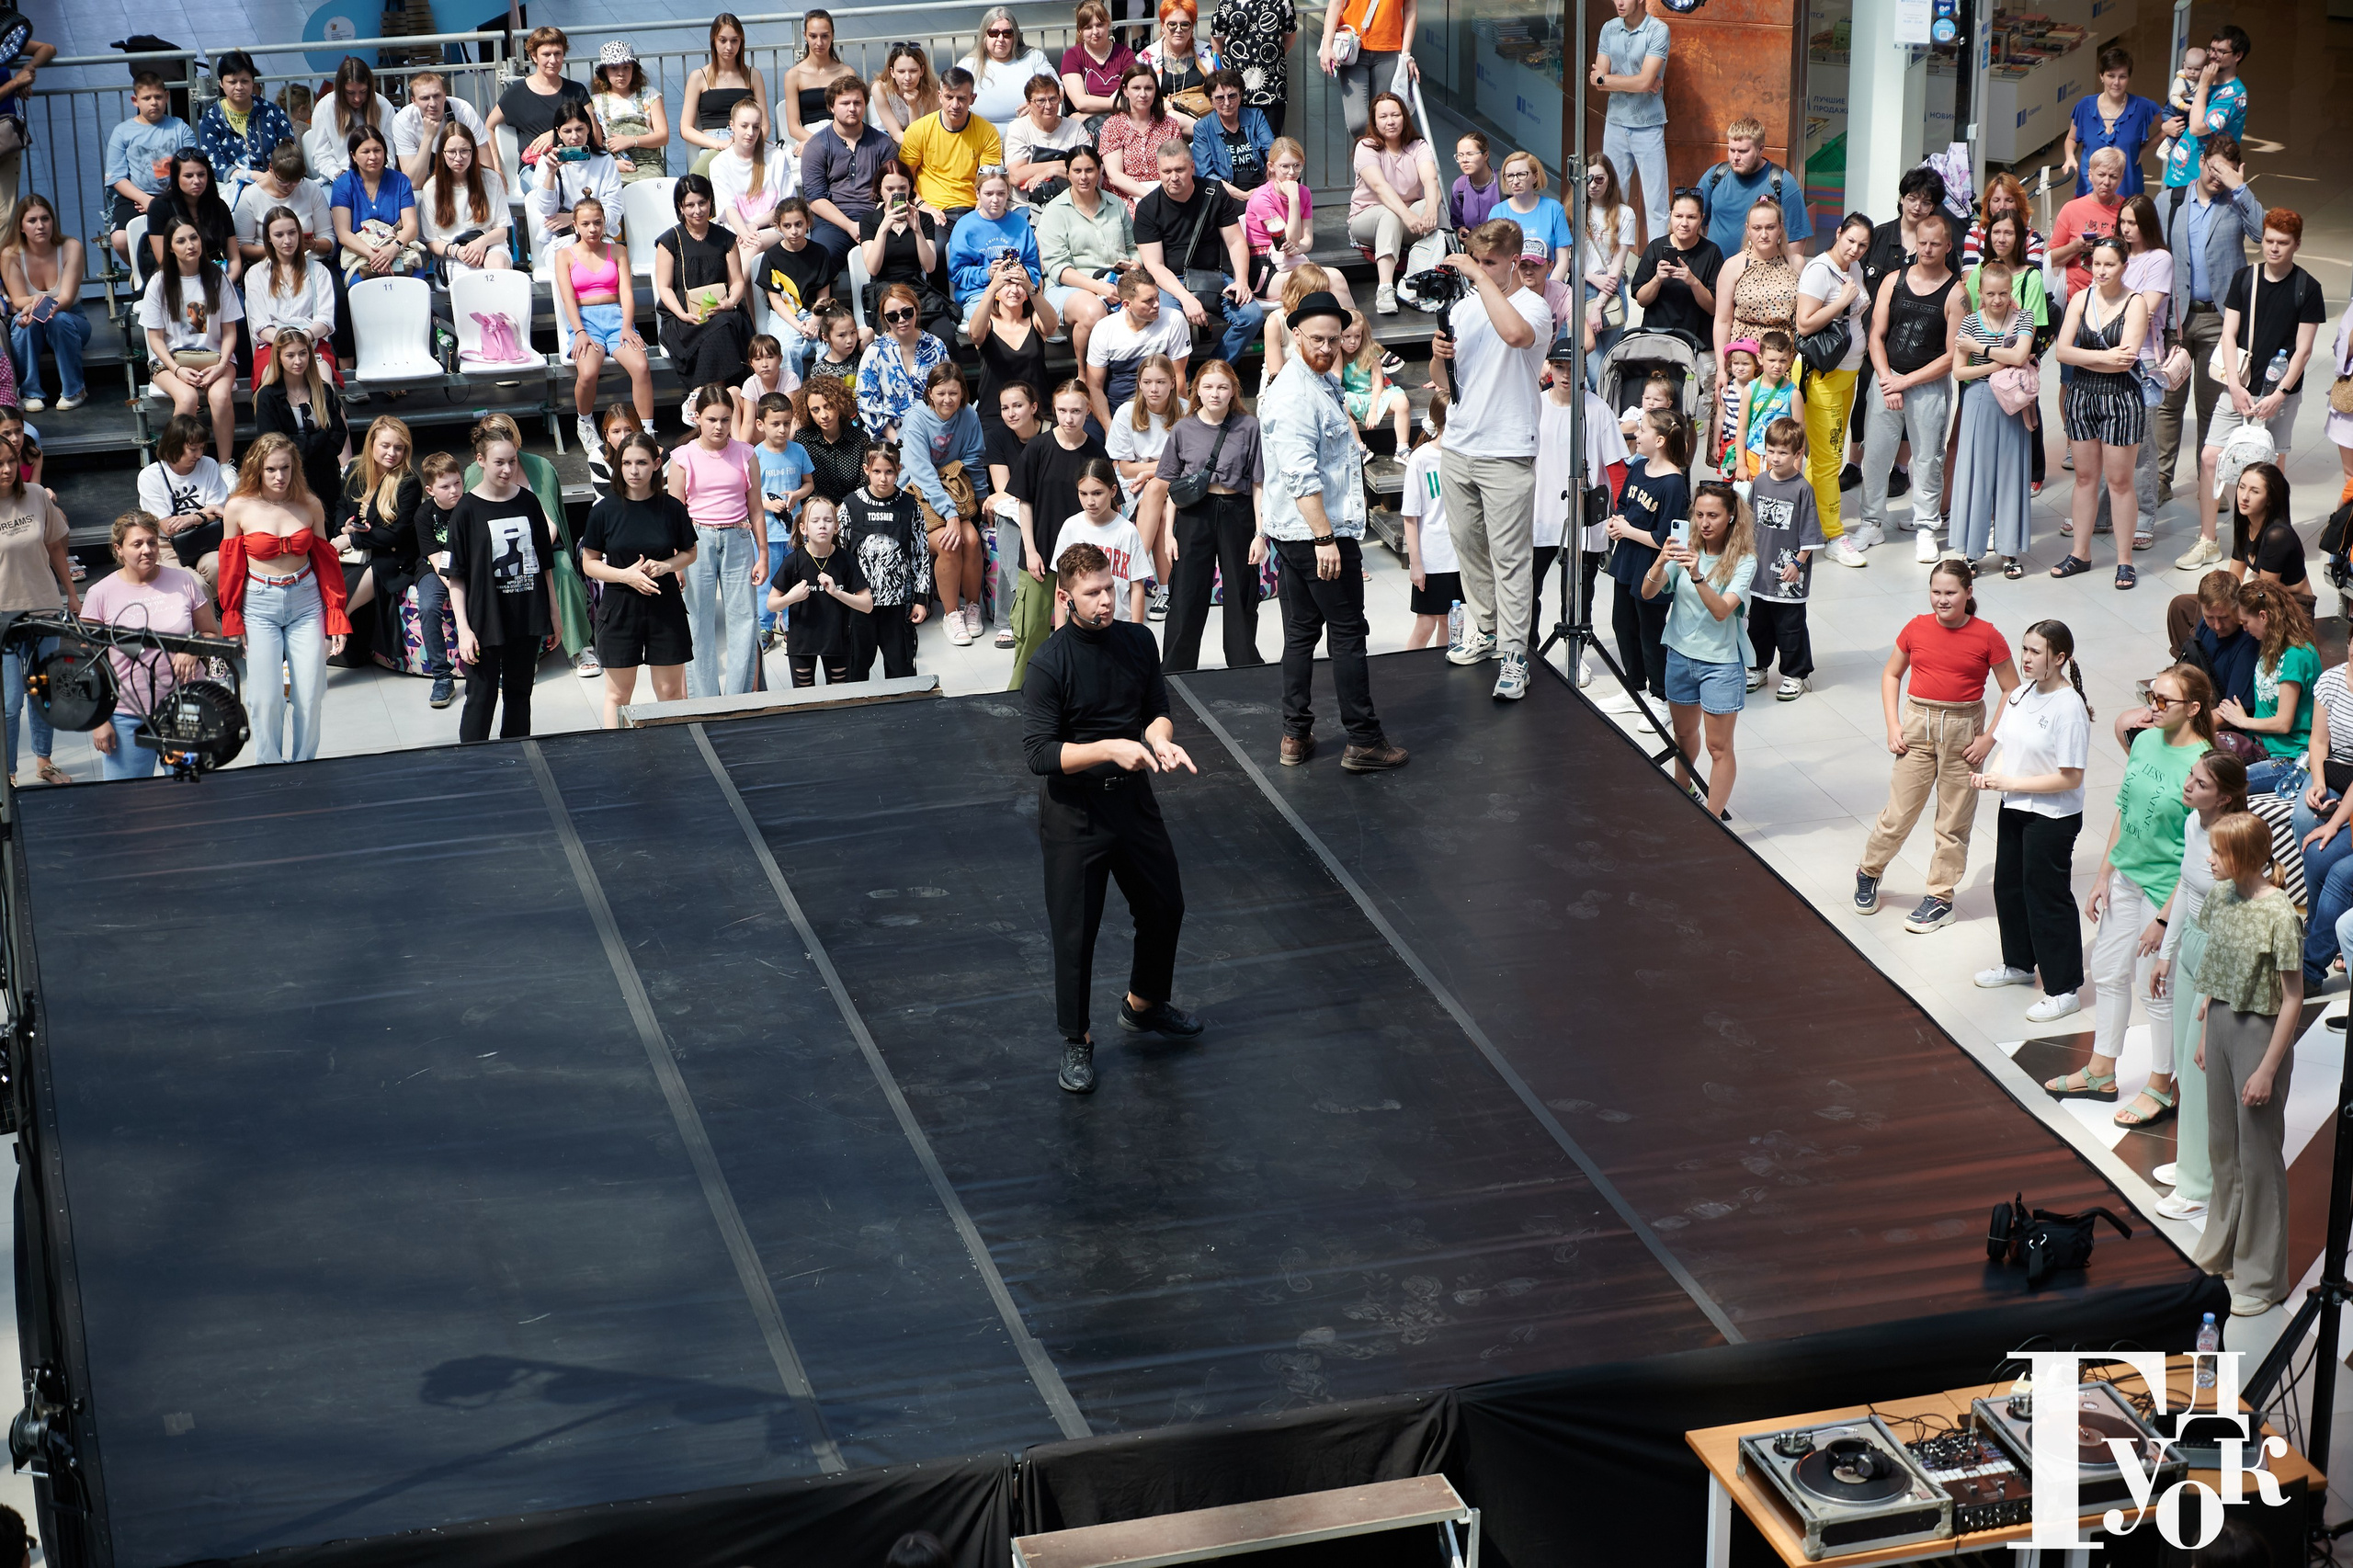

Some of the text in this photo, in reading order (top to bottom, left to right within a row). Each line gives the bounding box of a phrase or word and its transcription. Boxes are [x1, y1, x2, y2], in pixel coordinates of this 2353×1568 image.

[1813, 95, 1846, 105] ЛУЧШИЕ
[1236, 142, 1253, 154] ARE
[1627, 484, 1639, 499] ST
[2142, 761, 2165, 783] LESS
[2143, 786, 2165, 831] ONLINE
